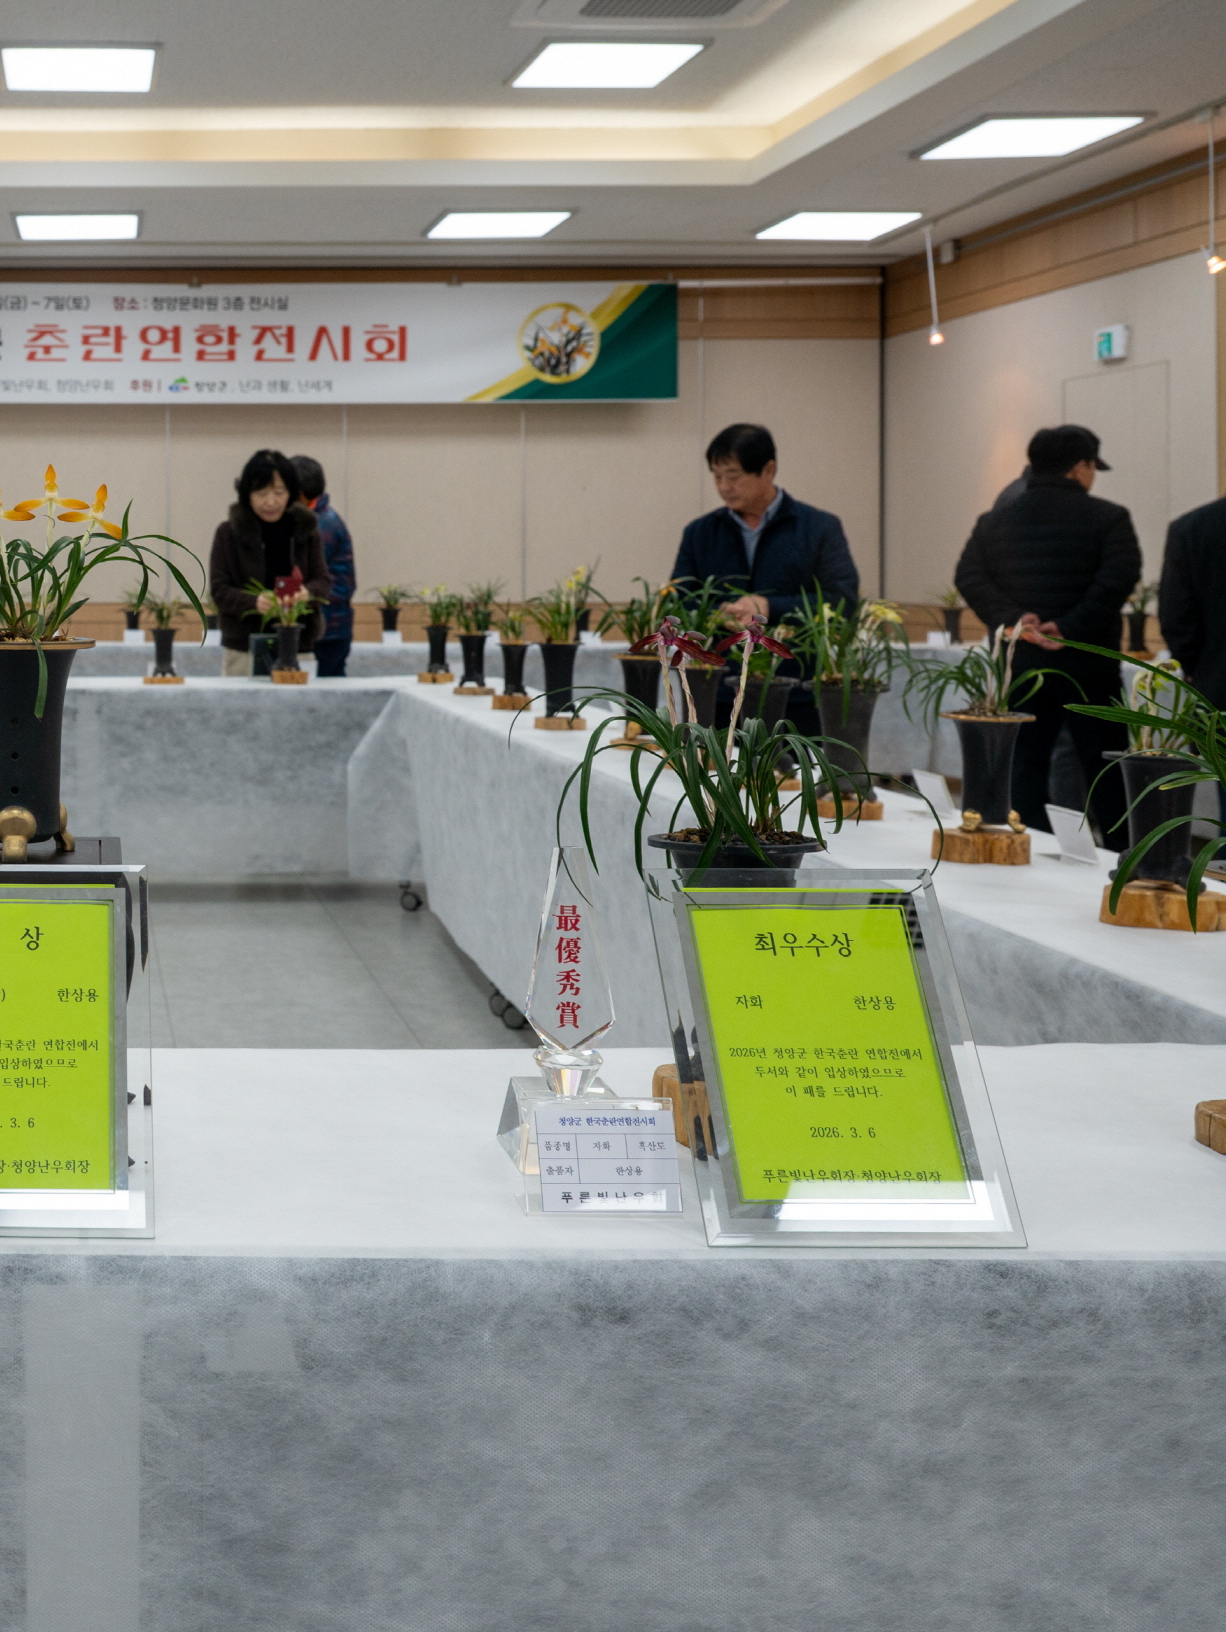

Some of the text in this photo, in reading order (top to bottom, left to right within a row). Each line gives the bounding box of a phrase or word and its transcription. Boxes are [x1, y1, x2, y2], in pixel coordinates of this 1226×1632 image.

[248, 295, 289, 312] 전시실
[24, 323, 408, 363] 춘란연합전시회
[754, 931, 854, 957] 최우수상
[554, 904, 581, 1029] 最優秀賞
[57, 988, 99, 1003] 한상용
[735, 994, 896, 1011] 자화 한상용
[43, 1039, 99, 1051] 연합전에서
[729, 1047, 923, 1060] 2026년 청양군 한국춘란 연합전에서
[755, 1066, 906, 1079] 두서와 같이 입상하였으므로
[2, 1076, 51, 1088] 드립니다.
[785, 1085, 883, 1098] 이 패를 드립니다.
[10, 1117, 20, 1129] 3.
[28, 1117, 35, 1129] 6
[559, 1116, 582, 1127] 청양군
[810, 1126, 876, 1139] 2026. 3. 6
[592, 1141, 611, 1152] 자화
[615, 1166, 642, 1176] 한상용
